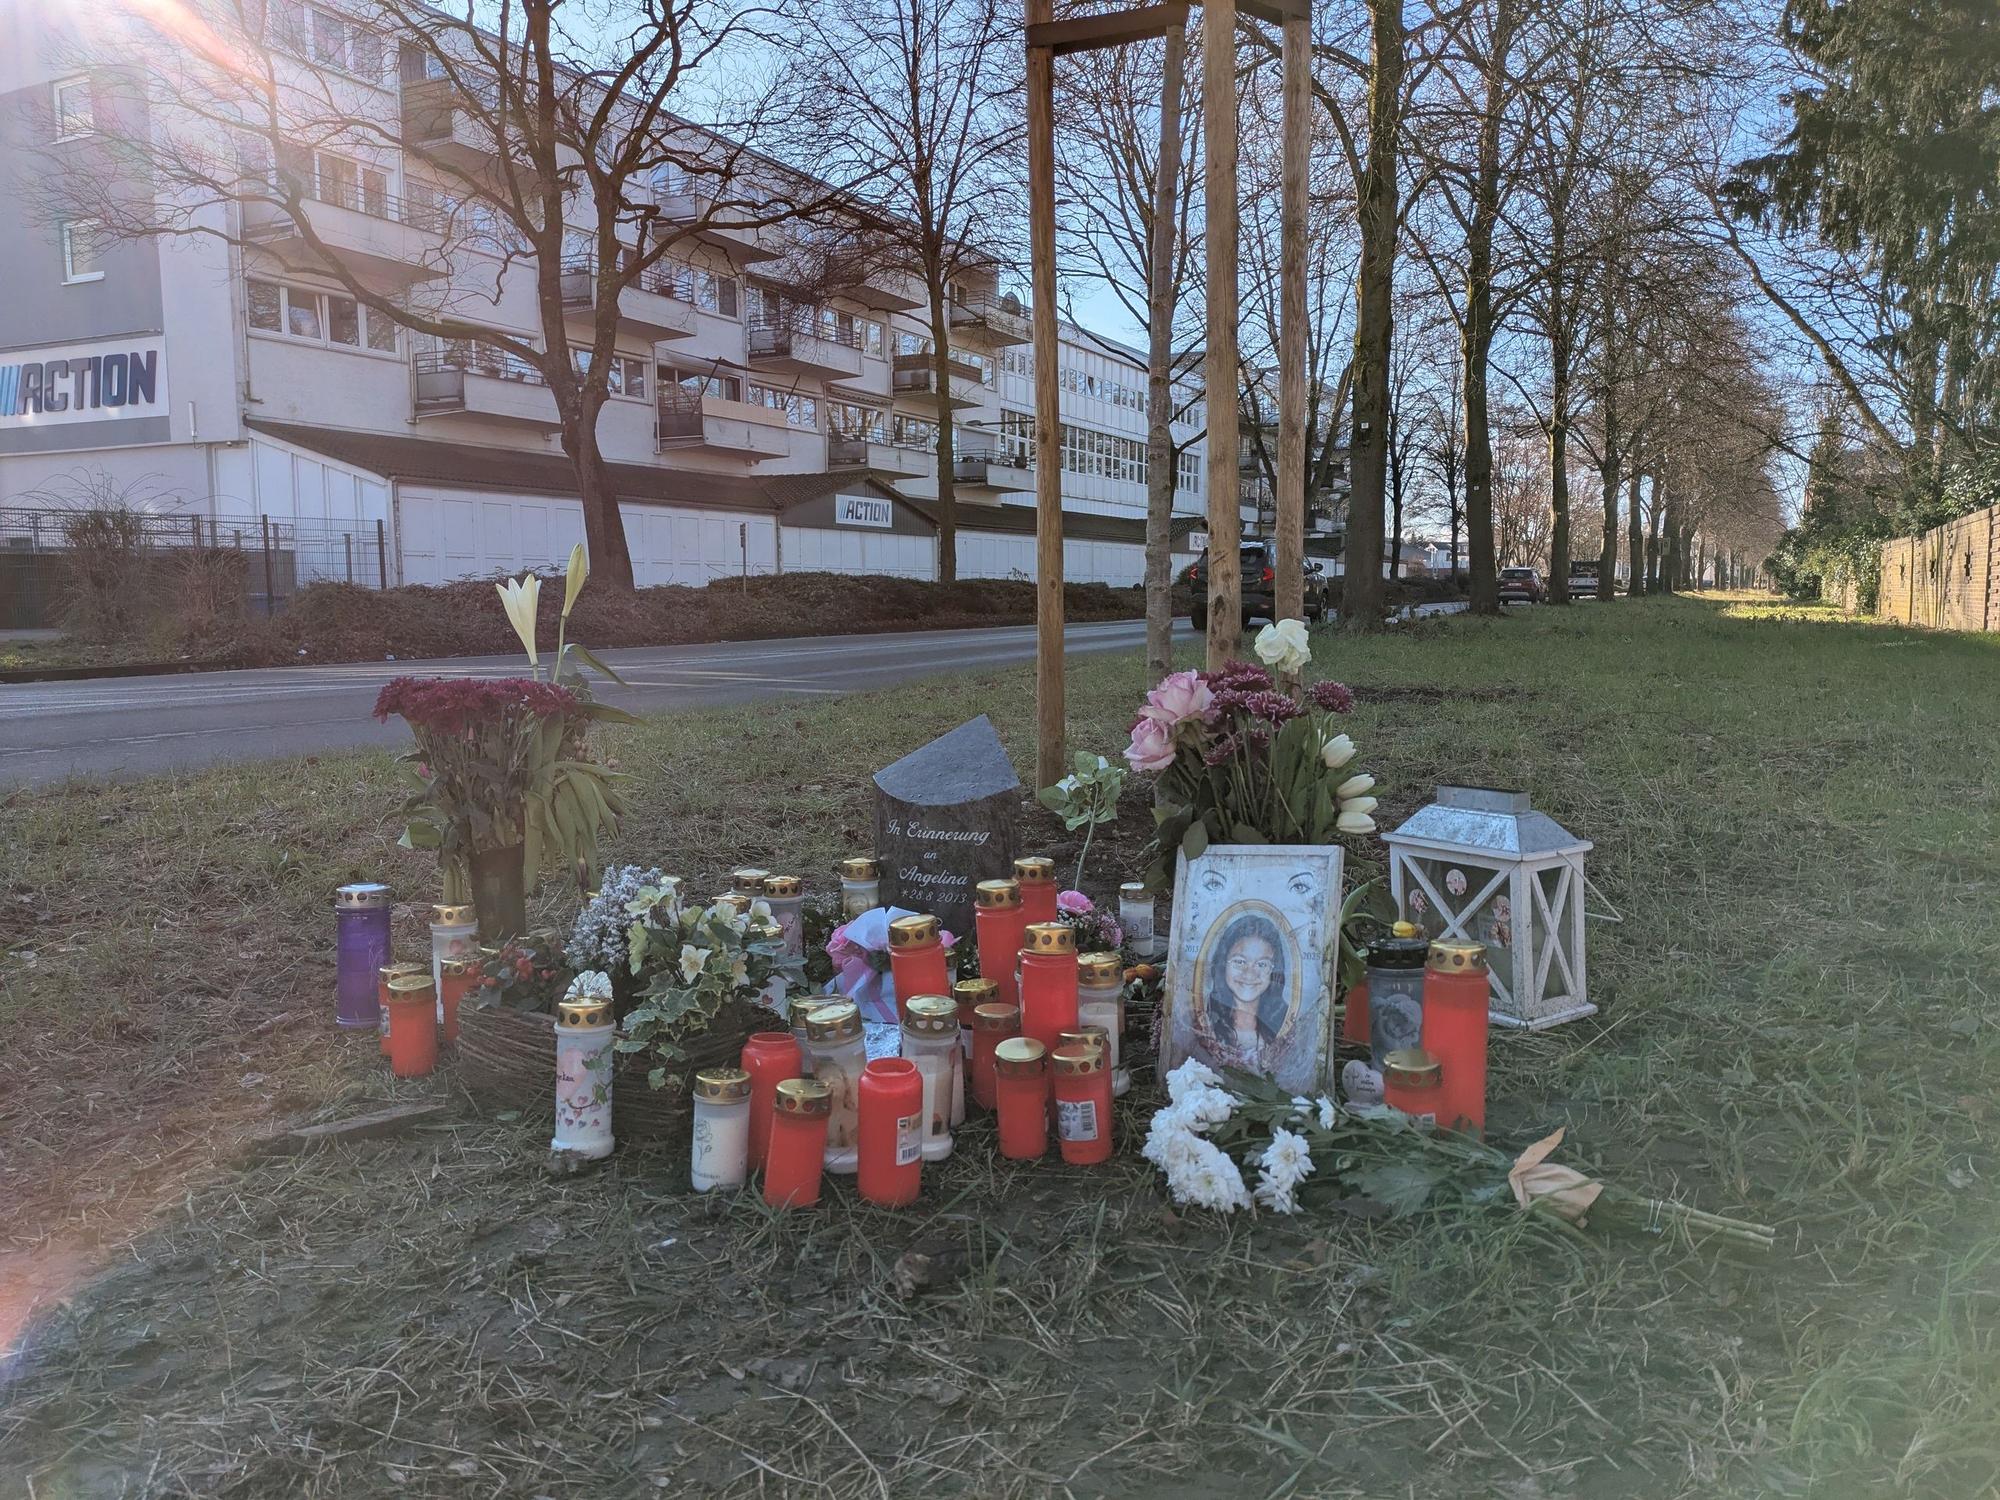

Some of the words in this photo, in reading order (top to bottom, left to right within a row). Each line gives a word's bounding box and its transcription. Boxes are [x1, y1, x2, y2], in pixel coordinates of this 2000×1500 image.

[17, 350, 158, 416] ACTION
[845, 500, 890, 523] ACTION
[887, 819, 901, 835] In
[906, 821, 990, 846] Erinnerung
[923, 851, 938, 860] an
[899, 865, 969, 887] Angelina
[936, 892, 968, 904] 2013
